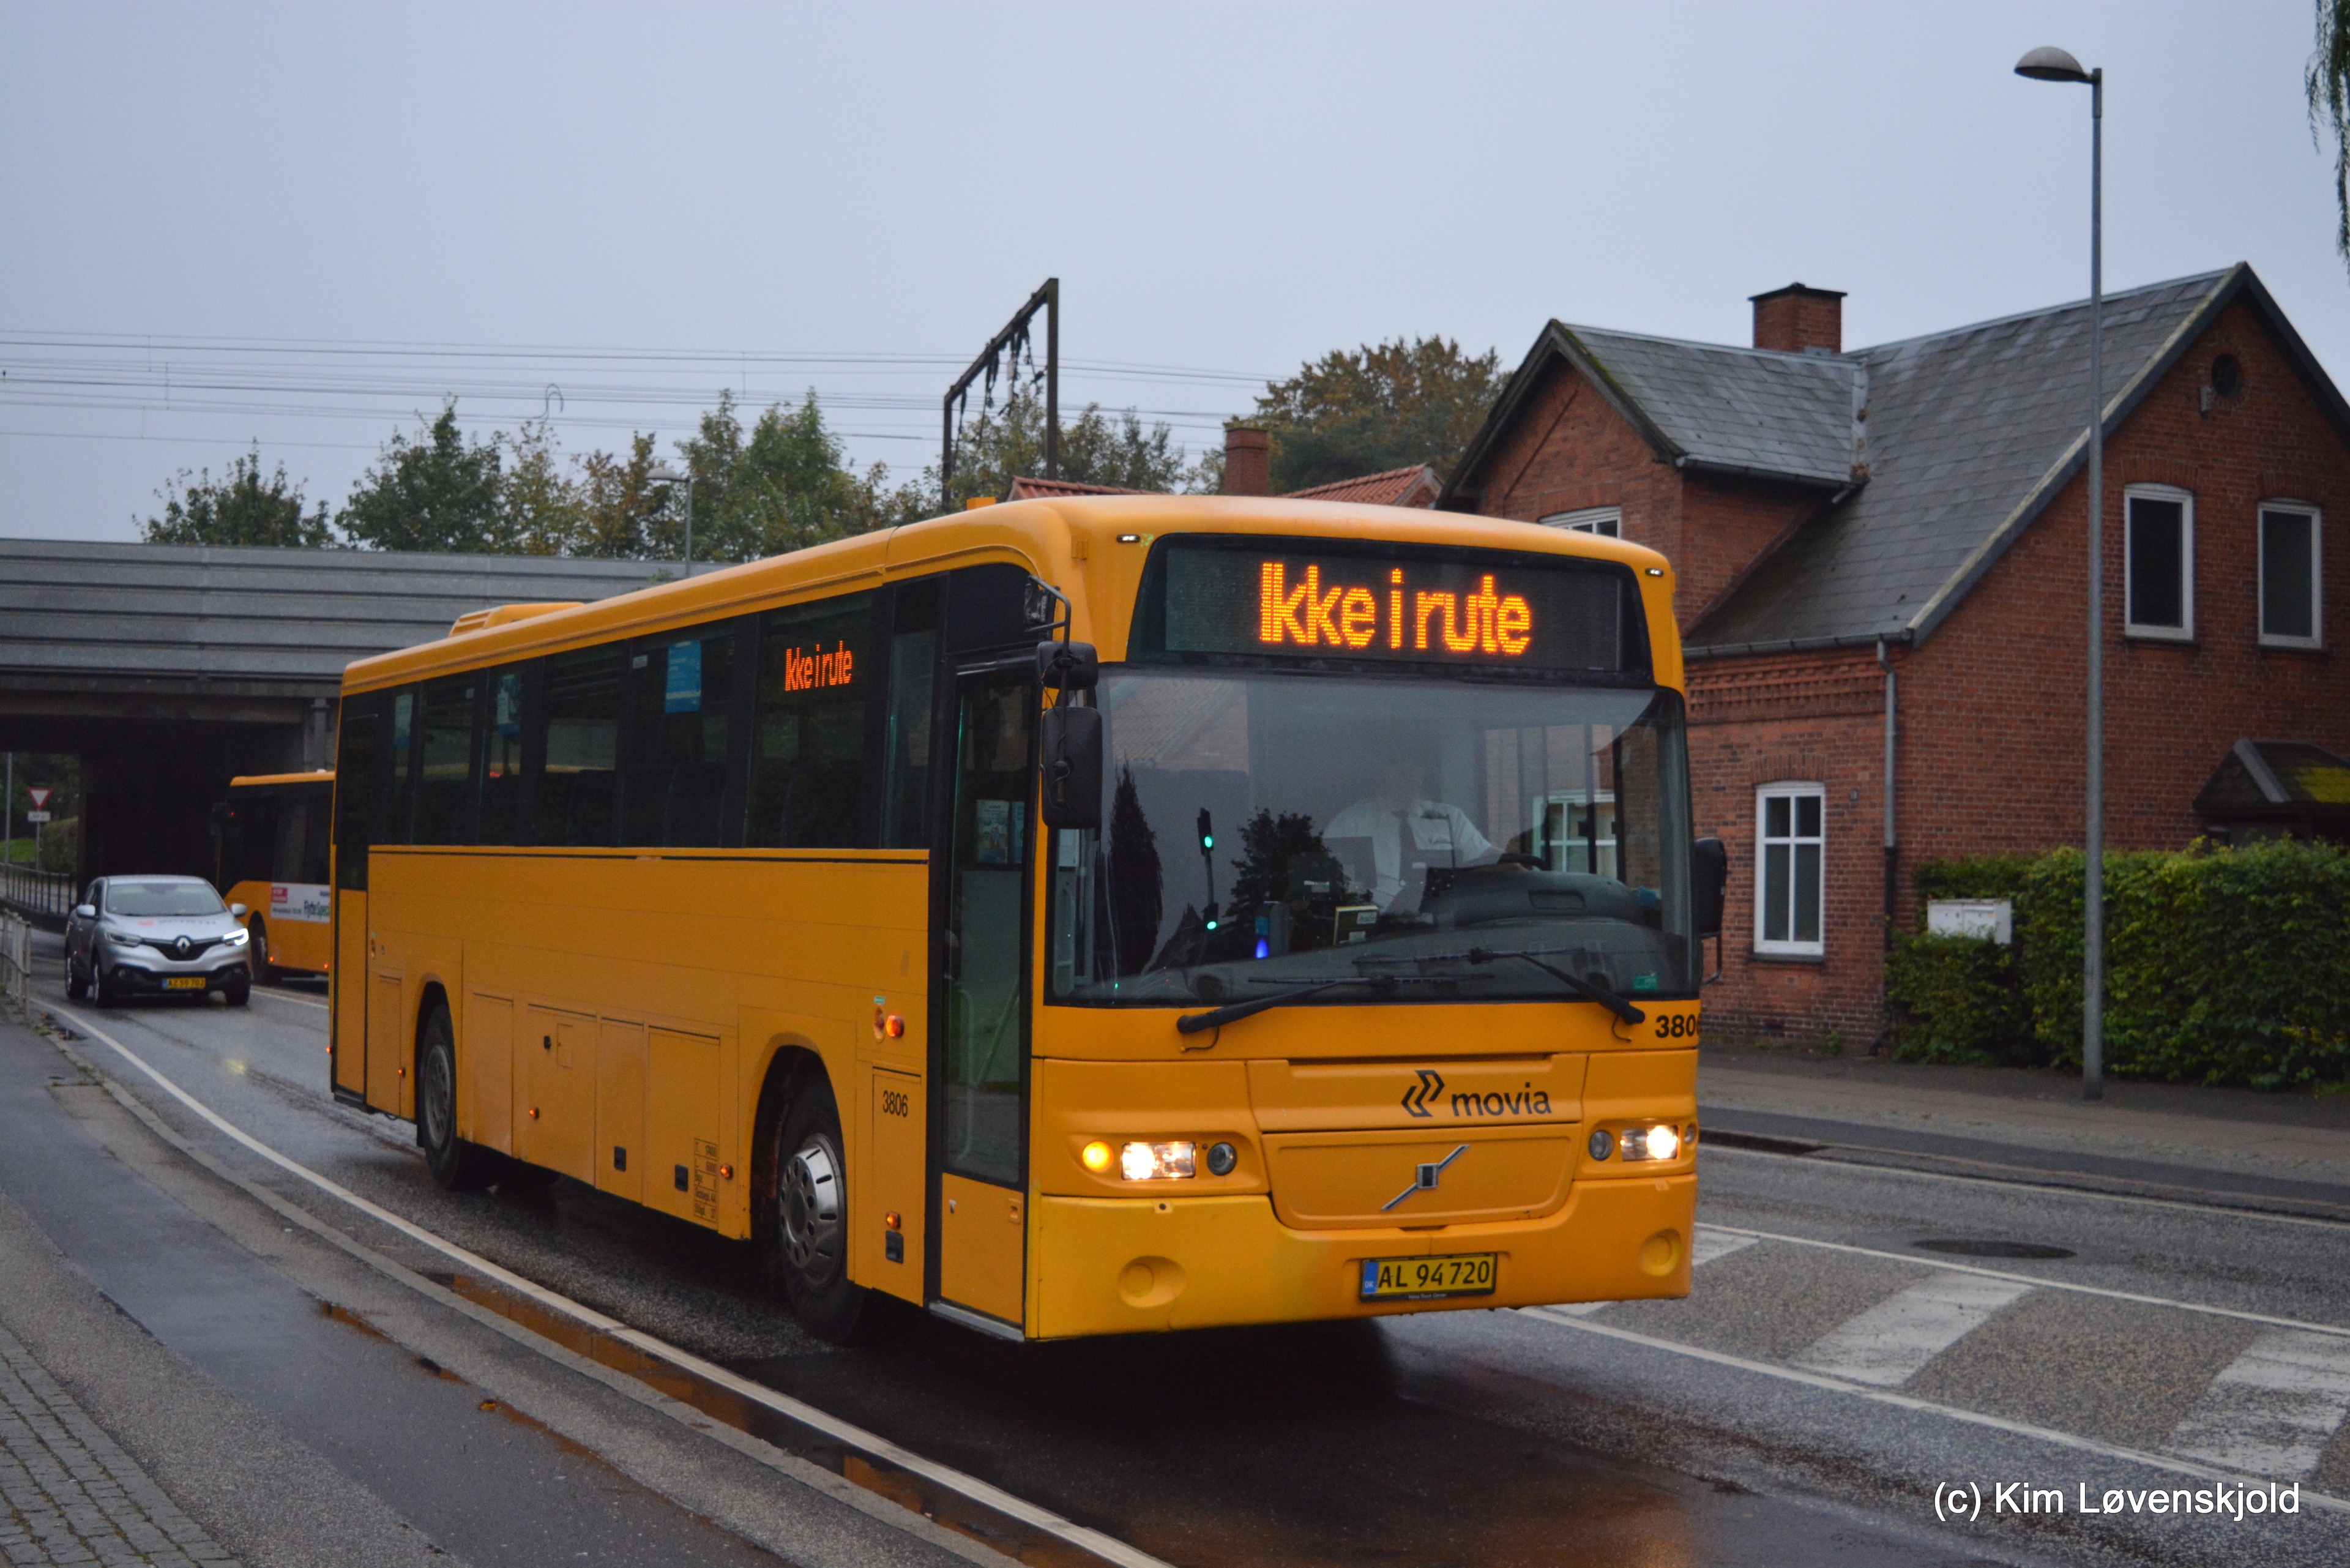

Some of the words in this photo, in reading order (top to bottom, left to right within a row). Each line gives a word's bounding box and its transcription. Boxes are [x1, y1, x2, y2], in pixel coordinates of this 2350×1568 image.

[1262, 562, 1376, 646] Ikke
[1390, 568, 1401, 649] i
[1416, 574, 1529, 653] rute
[785, 647, 813, 691] Ikke
[815, 643, 821, 687] i
[821, 640, 852, 686] rute
[882, 1090, 908, 1118] 3806
[1451, 1081, 1553, 1117] movia
[1378, 1265, 1408, 1288] AL
[1416, 1263, 1443, 1288] 94
[1450, 1260, 1490, 1285] 720
